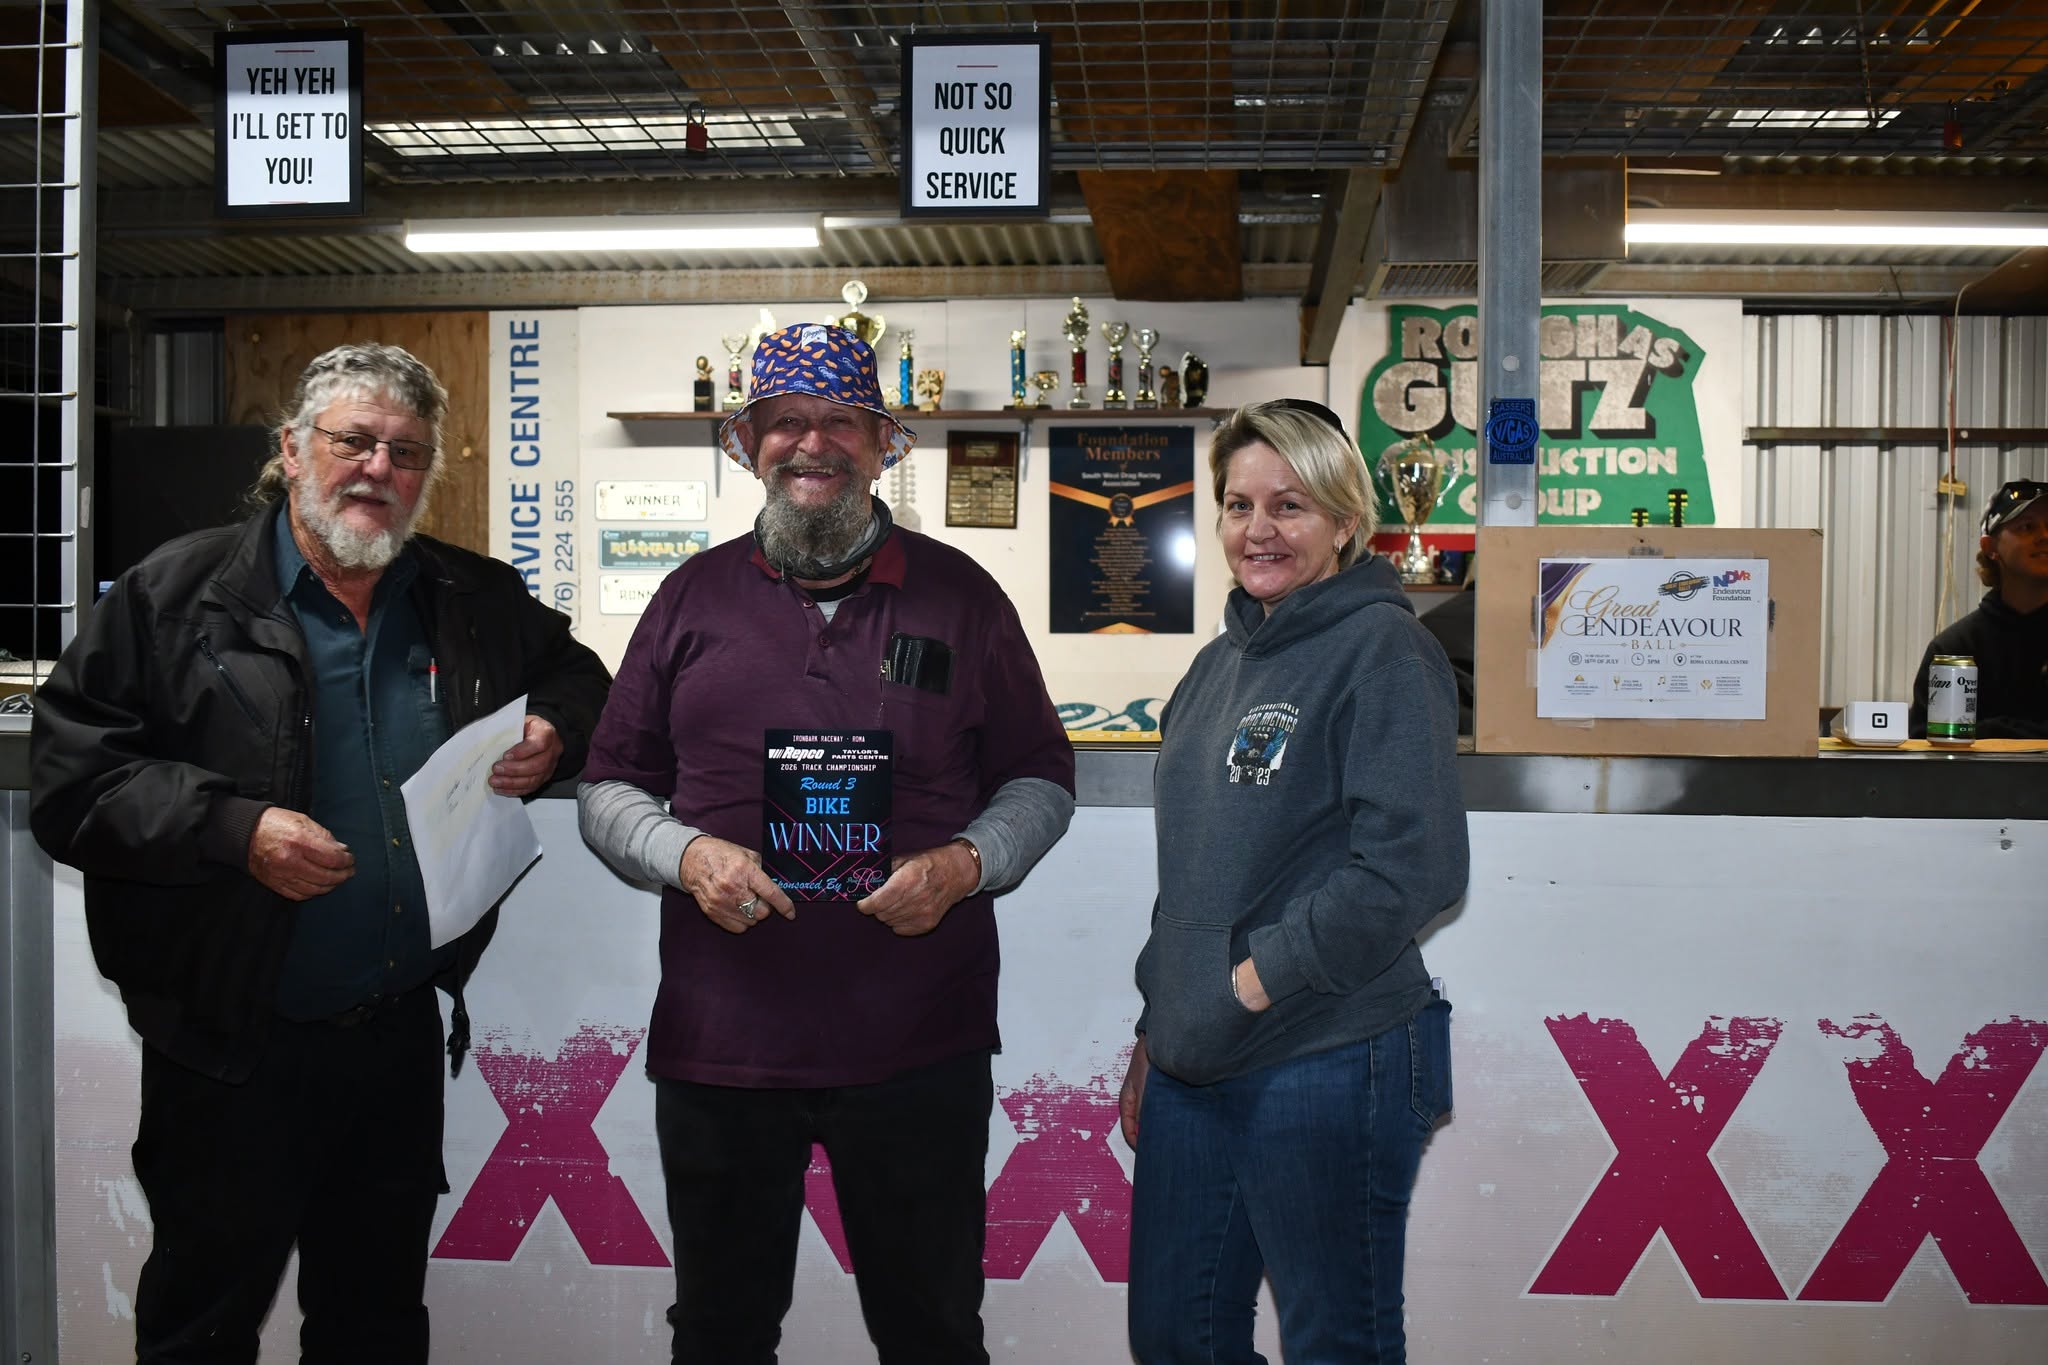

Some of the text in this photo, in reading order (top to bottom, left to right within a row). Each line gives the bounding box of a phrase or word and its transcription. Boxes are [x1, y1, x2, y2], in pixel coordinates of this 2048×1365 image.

[247, 67, 335, 95] YEH YEH
[934, 82, 1013, 110] NOT SO
[232, 112, 348, 140] I'LL GET TO
[939, 127, 1006, 157] QUICK
[265, 157, 313, 185] YOU!
[926, 172, 1017, 200] SERVICE
[1402, 314, 1681, 369] ROGH AS
[1493, 402, 1532, 413] GASSERS
[1077, 431, 1168, 447] Foundation
[510, 319, 541, 600] RVICE CENTRE
[1086, 446, 1161, 461] Members
[1493, 451, 1532, 461] AUSTRALIA
[555, 479, 574, 523] 555
[624, 494, 681, 506] WINNER
[554, 531, 574, 572] 224
[1568, 586, 1660, 622] Great
[1583, 617, 1743, 638] ENDEAVOUR
[1631, 639, 1676, 650] BALL
[793, 735, 866, 743] IRONBARK RACEWAY ROMA
[781, 746, 825, 762] Repco
[780, 763, 798, 771] 2026
[826, 764, 877, 772] CHAMPIONSHIP
[1229, 765, 1271, 786] 20 23
[800, 777, 857, 791] Round 3
[805, 797, 851, 815] BIKE
[769, 822, 881, 852] WINNER
[826, 877, 842, 893] By
